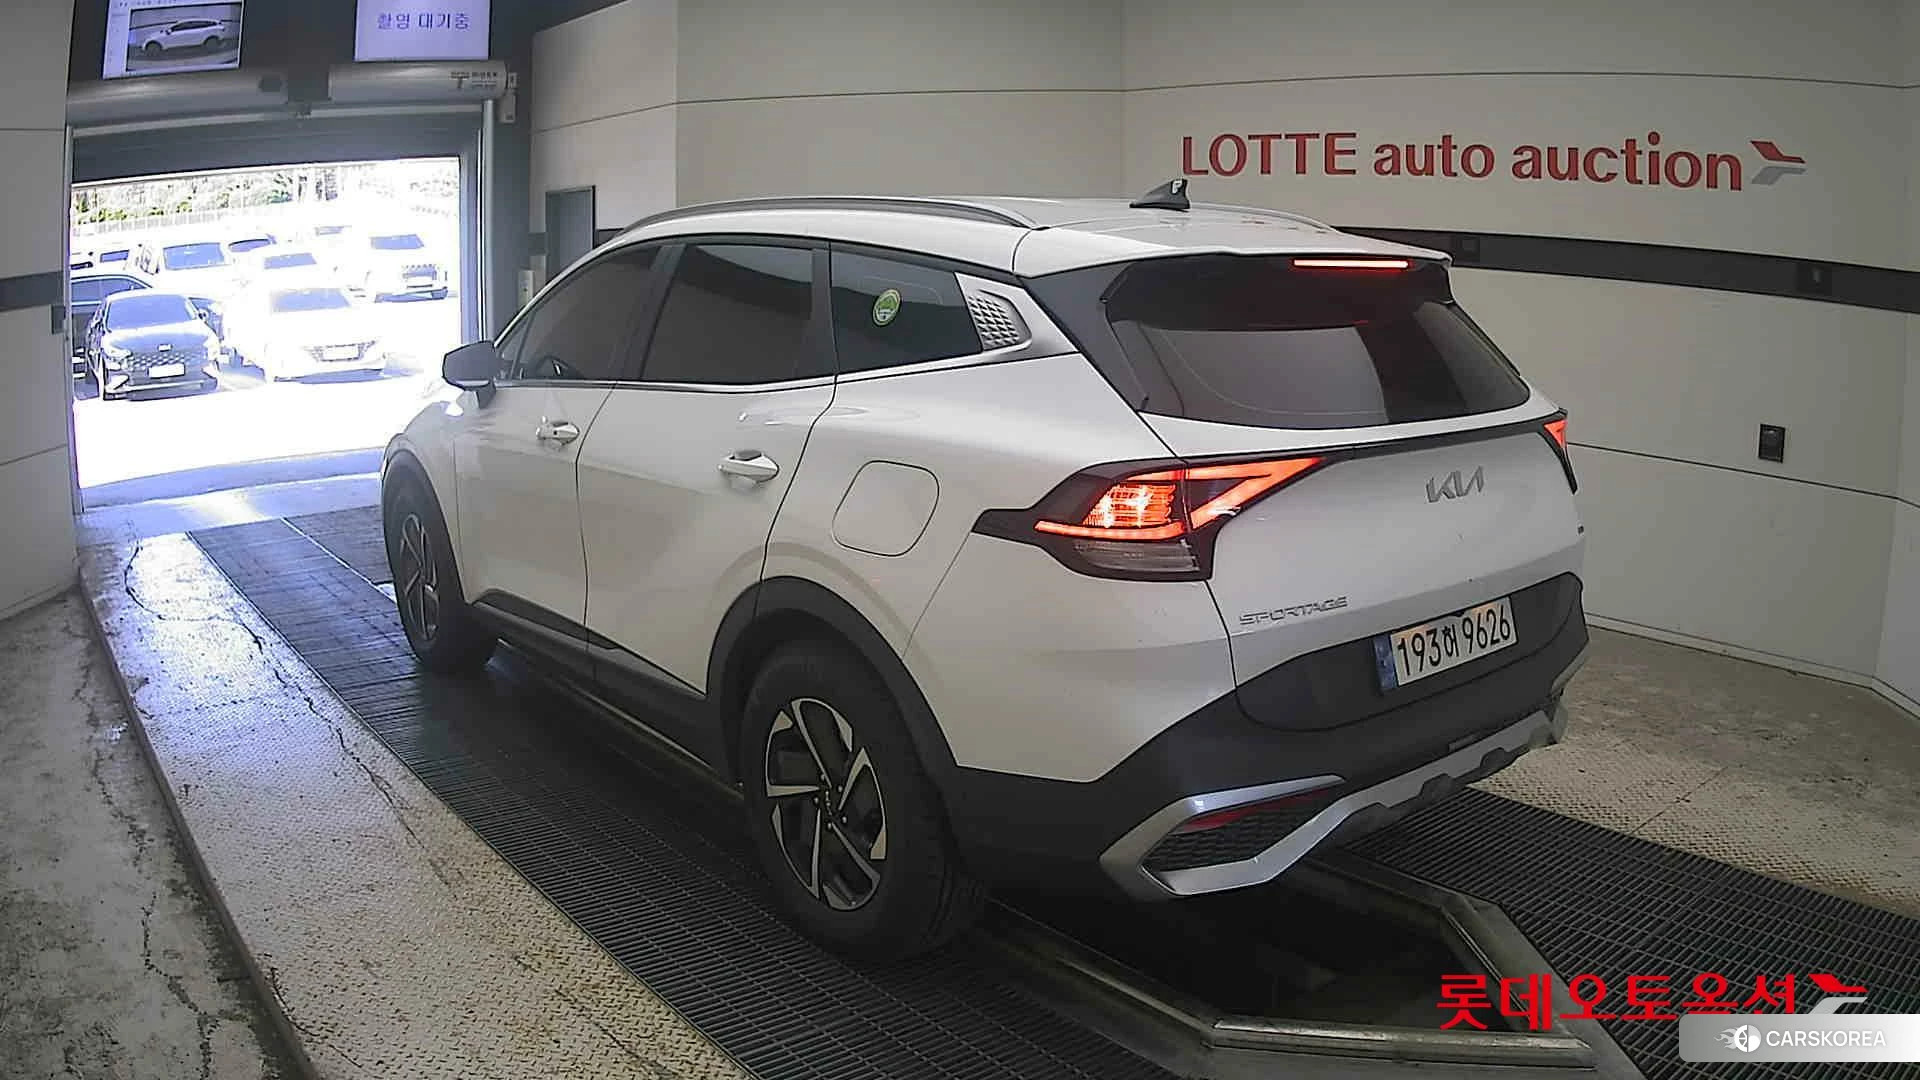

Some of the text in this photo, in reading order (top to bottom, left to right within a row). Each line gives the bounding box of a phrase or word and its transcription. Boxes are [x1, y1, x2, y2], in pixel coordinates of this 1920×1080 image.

[1182, 131, 1743, 191] LOTTE auto auction
[1239, 595, 1348, 625] SPORTAGE
